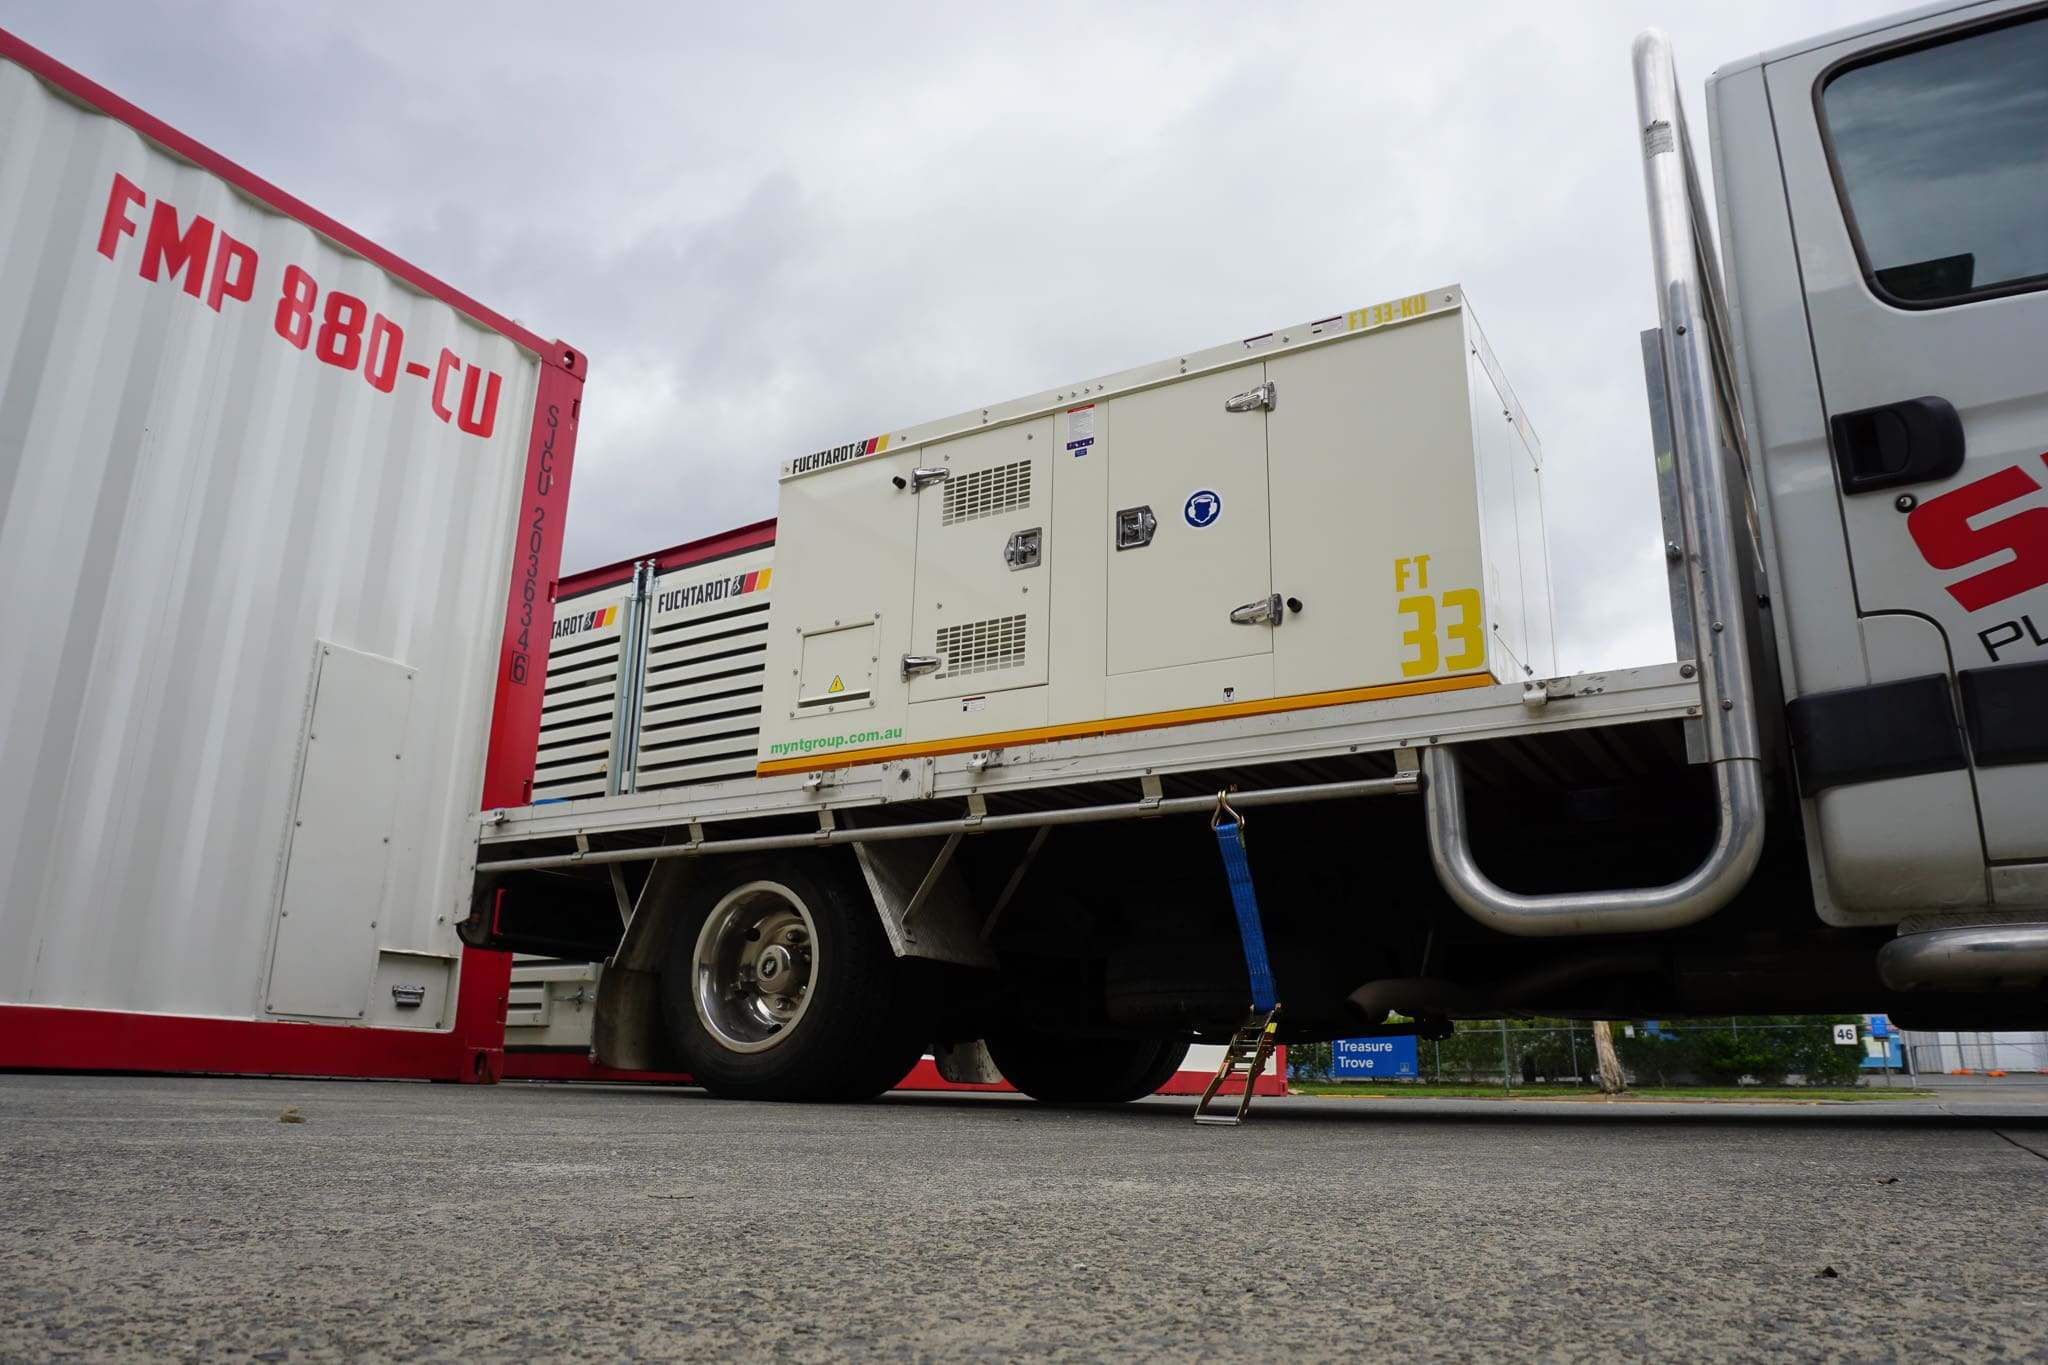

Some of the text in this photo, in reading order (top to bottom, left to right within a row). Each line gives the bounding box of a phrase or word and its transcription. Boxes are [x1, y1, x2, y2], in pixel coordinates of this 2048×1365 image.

[97, 172, 503, 439] FMP 880-CU
[1349, 310, 1367, 331] FT
[537, 404, 559, 496] SJCU
[792, 443, 855, 475] FUCHTARDT
[1907, 451, 2048, 613] S
[1394, 554, 1431, 593] FT
[658, 578, 731, 614] FUCHTARDT
[1398, 588, 1485, 677] 33
[770, 727, 903, 755] myntgroup.com.au
[1337, 1039, 1393, 1053] Treasure
[1837, 1028, 1854, 1041] 46
[1338, 1056, 1374, 1069] Trove
